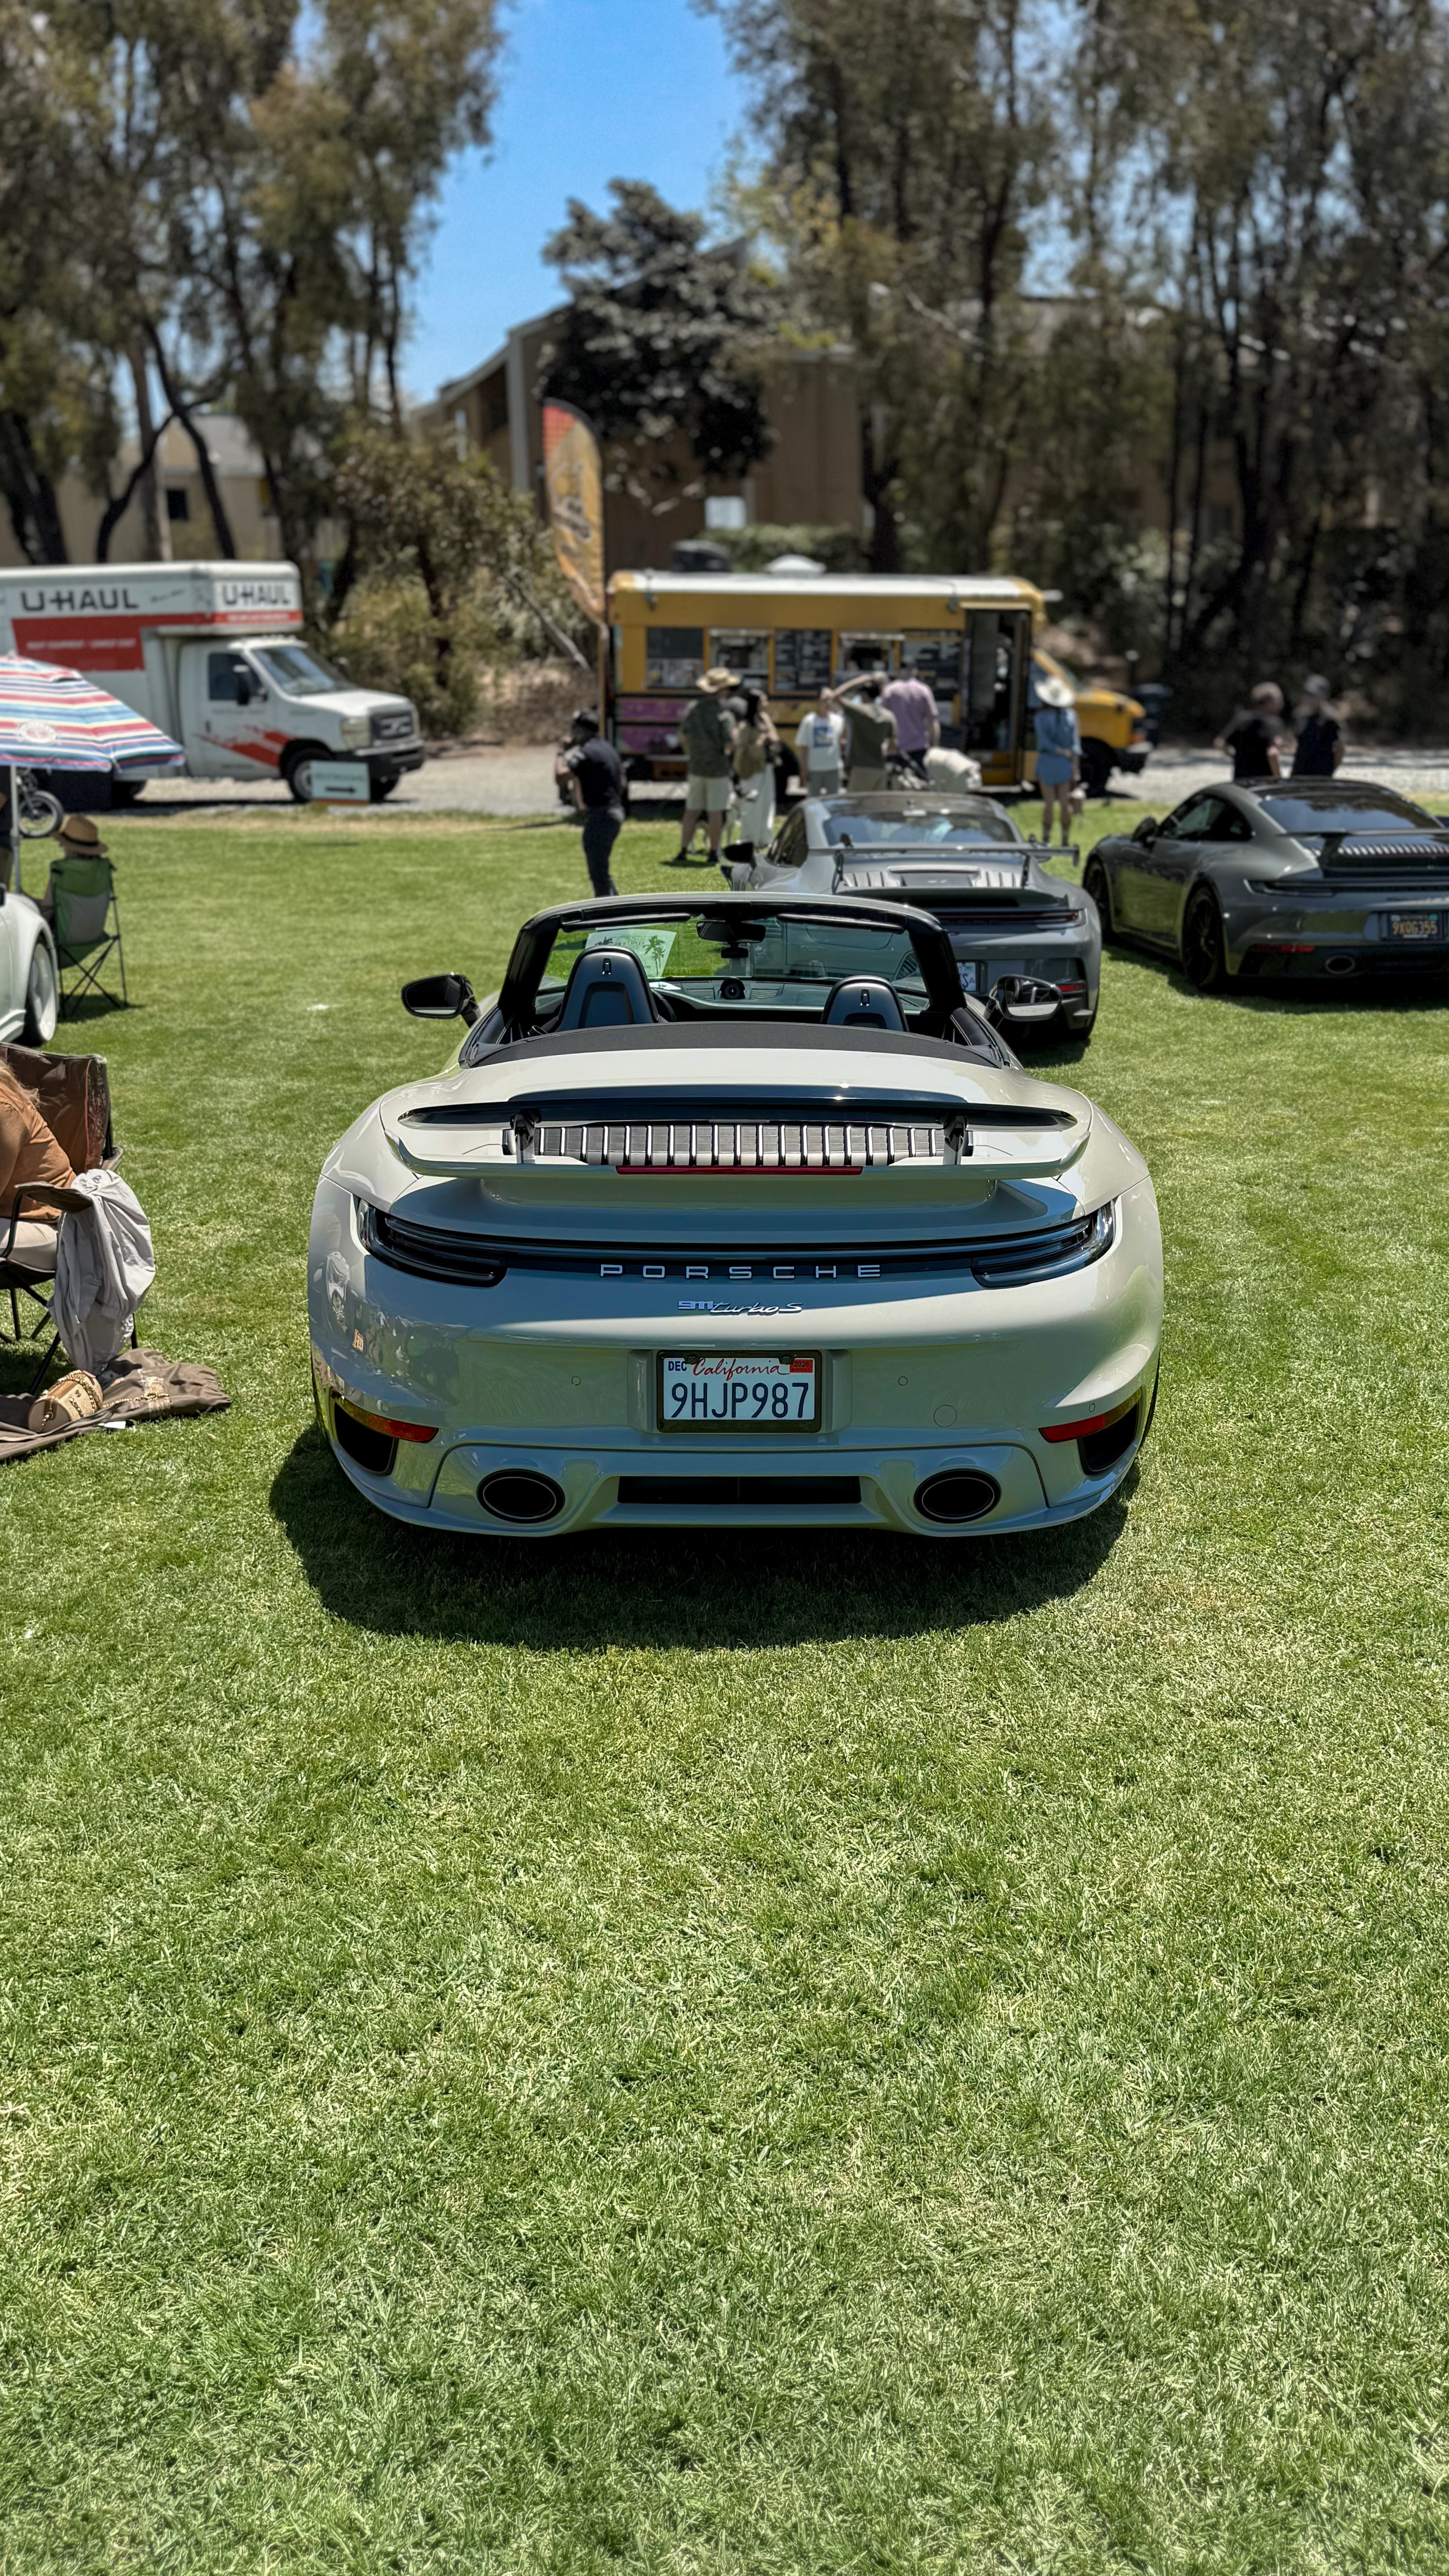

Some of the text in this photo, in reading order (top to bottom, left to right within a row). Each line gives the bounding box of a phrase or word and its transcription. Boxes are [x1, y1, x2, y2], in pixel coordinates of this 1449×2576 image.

[20, 588, 139, 611] U-HAUL
[600, 1264, 881, 1280] PORSCHE
[778, 1302, 803, 1314] S
[668, 1358, 790, 1381] DEC California
[671, 1382, 809, 1418] 9HJP987
